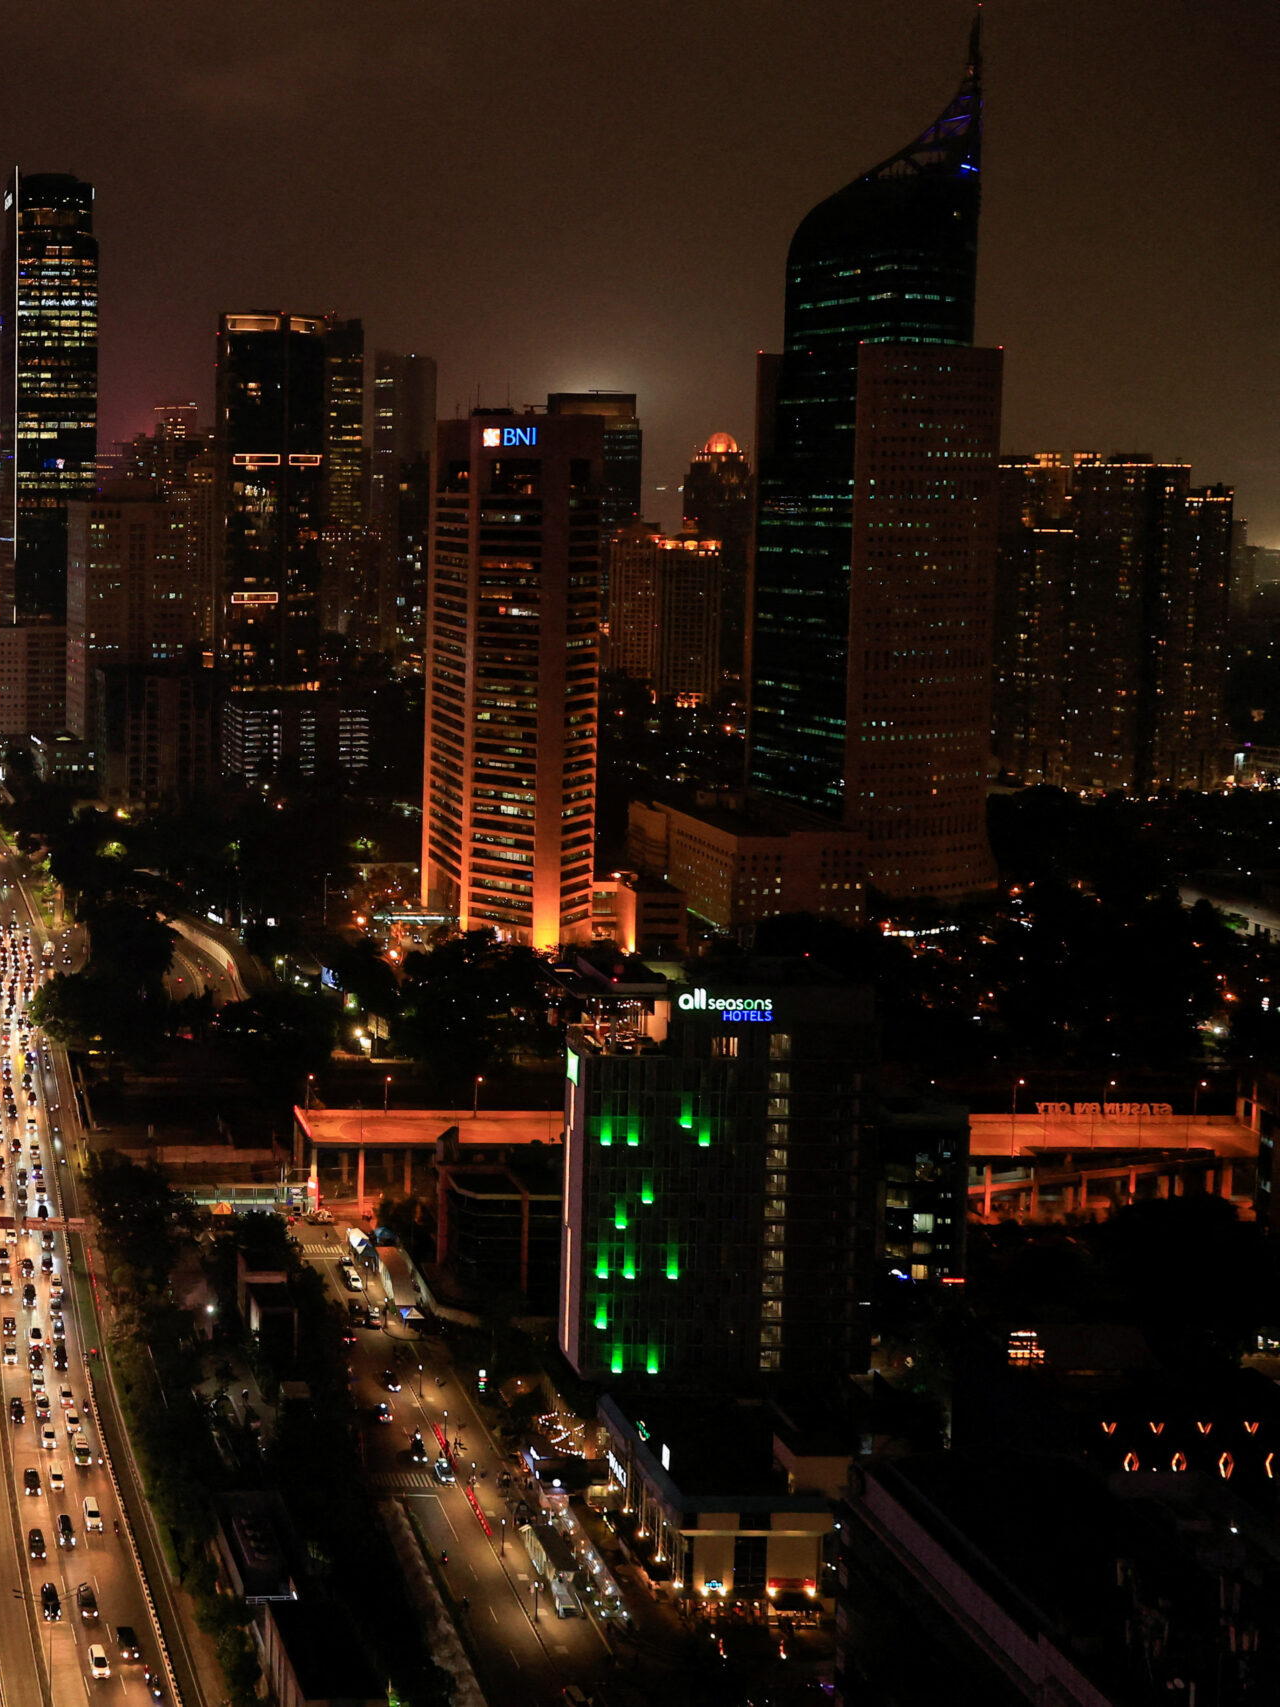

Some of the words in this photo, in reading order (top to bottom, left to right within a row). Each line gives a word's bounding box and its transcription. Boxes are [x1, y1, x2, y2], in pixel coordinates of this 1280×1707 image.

[503, 427, 537, 446] BNI
[678, 987, 707, 1010] all
[708, 998, 773, 1010] seasons
[723, 1010, 773, 1022] HOTELS
